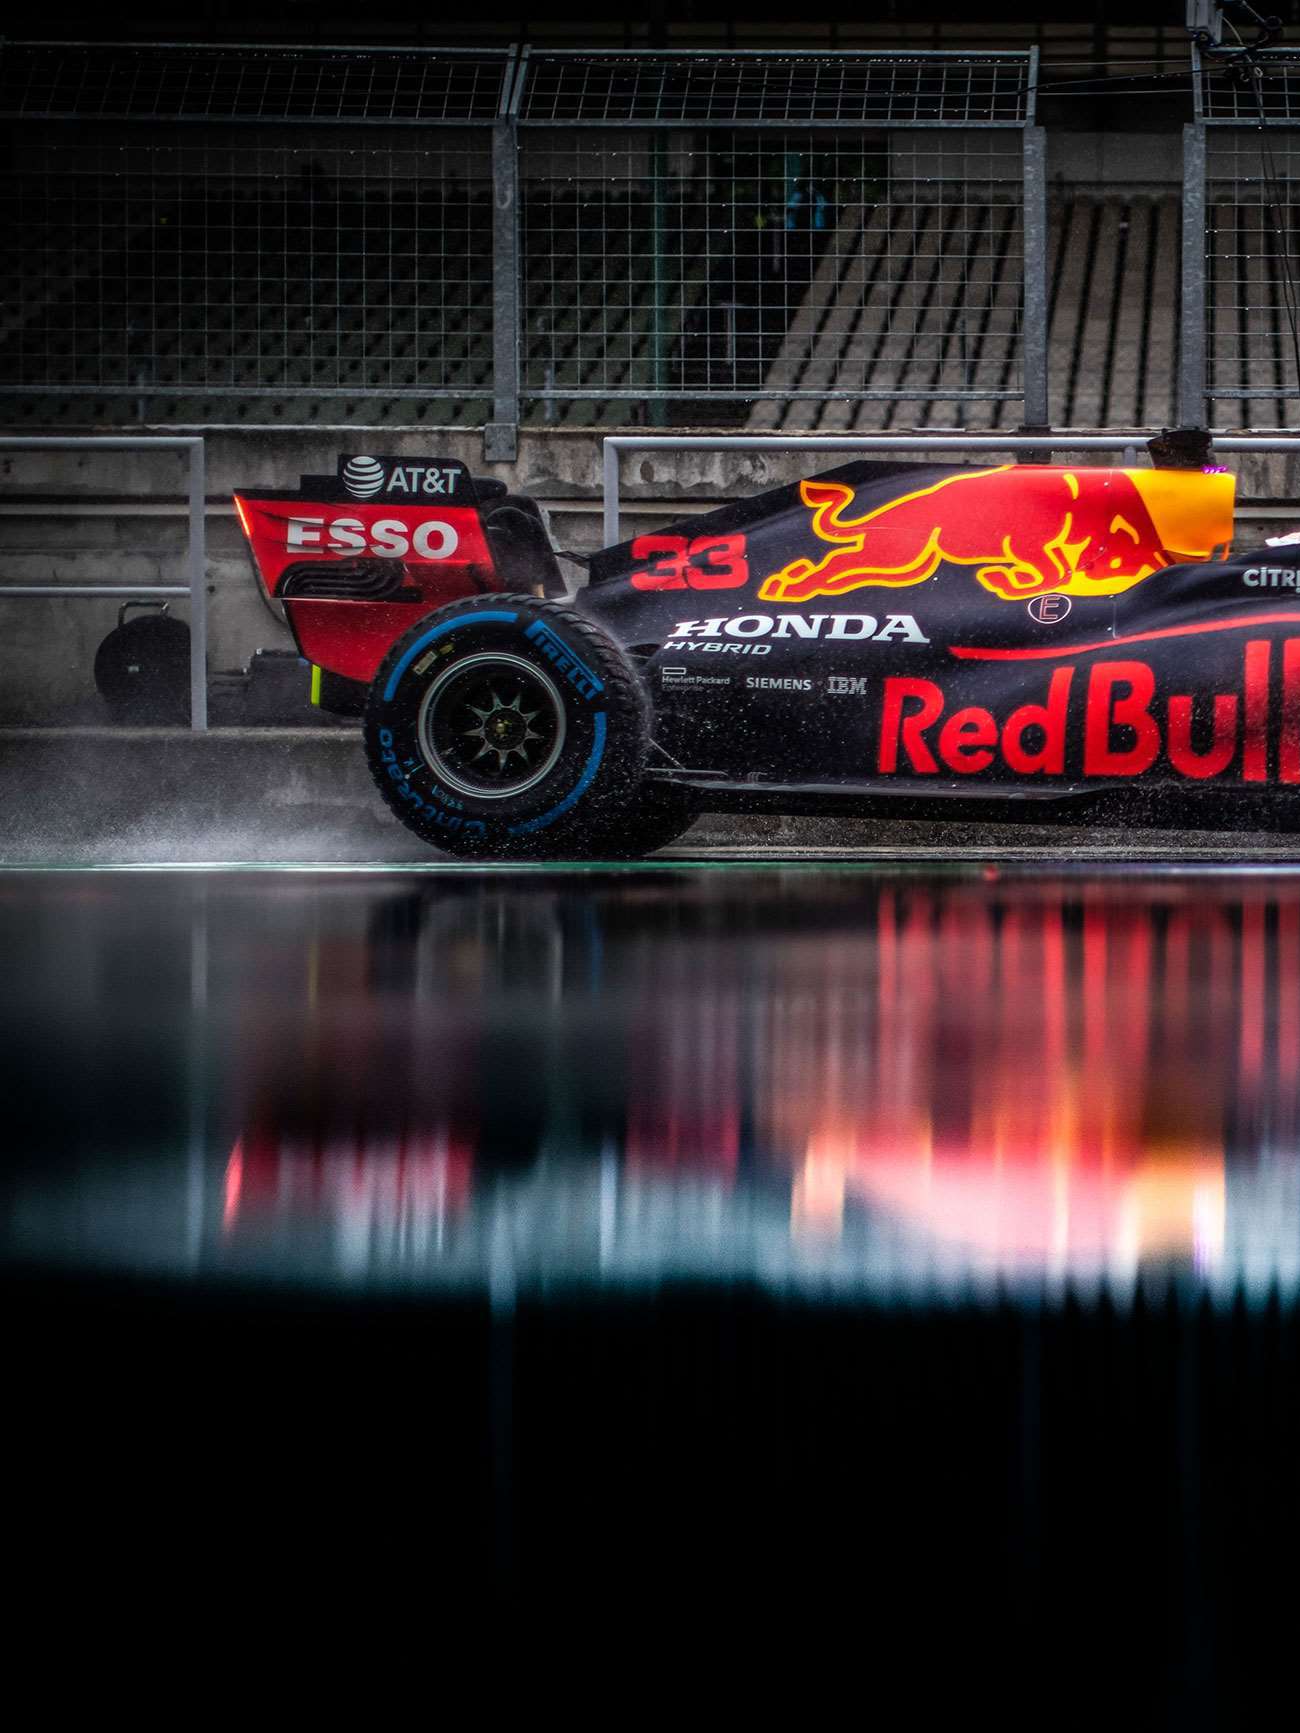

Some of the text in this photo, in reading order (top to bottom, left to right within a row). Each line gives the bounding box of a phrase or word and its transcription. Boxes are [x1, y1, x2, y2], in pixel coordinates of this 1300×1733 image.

[386, 466, 461, 494] AT&T
[286, 517, 459, 559] ESSO
[631, 534, 748, 591] 33
[1039, 595, 1060, 620] E
[667, 614, 930, 643] HONDA
[523, 619, 605, 701] PIRELLI
[663, 641, 771, 655] HYBRID
[696, 676, 730, 686] Packard
[746, 677, 812, 691] SIEMENS
[827, 676, 868, 694] IBM
[878, 666, 1075, 775] Red
